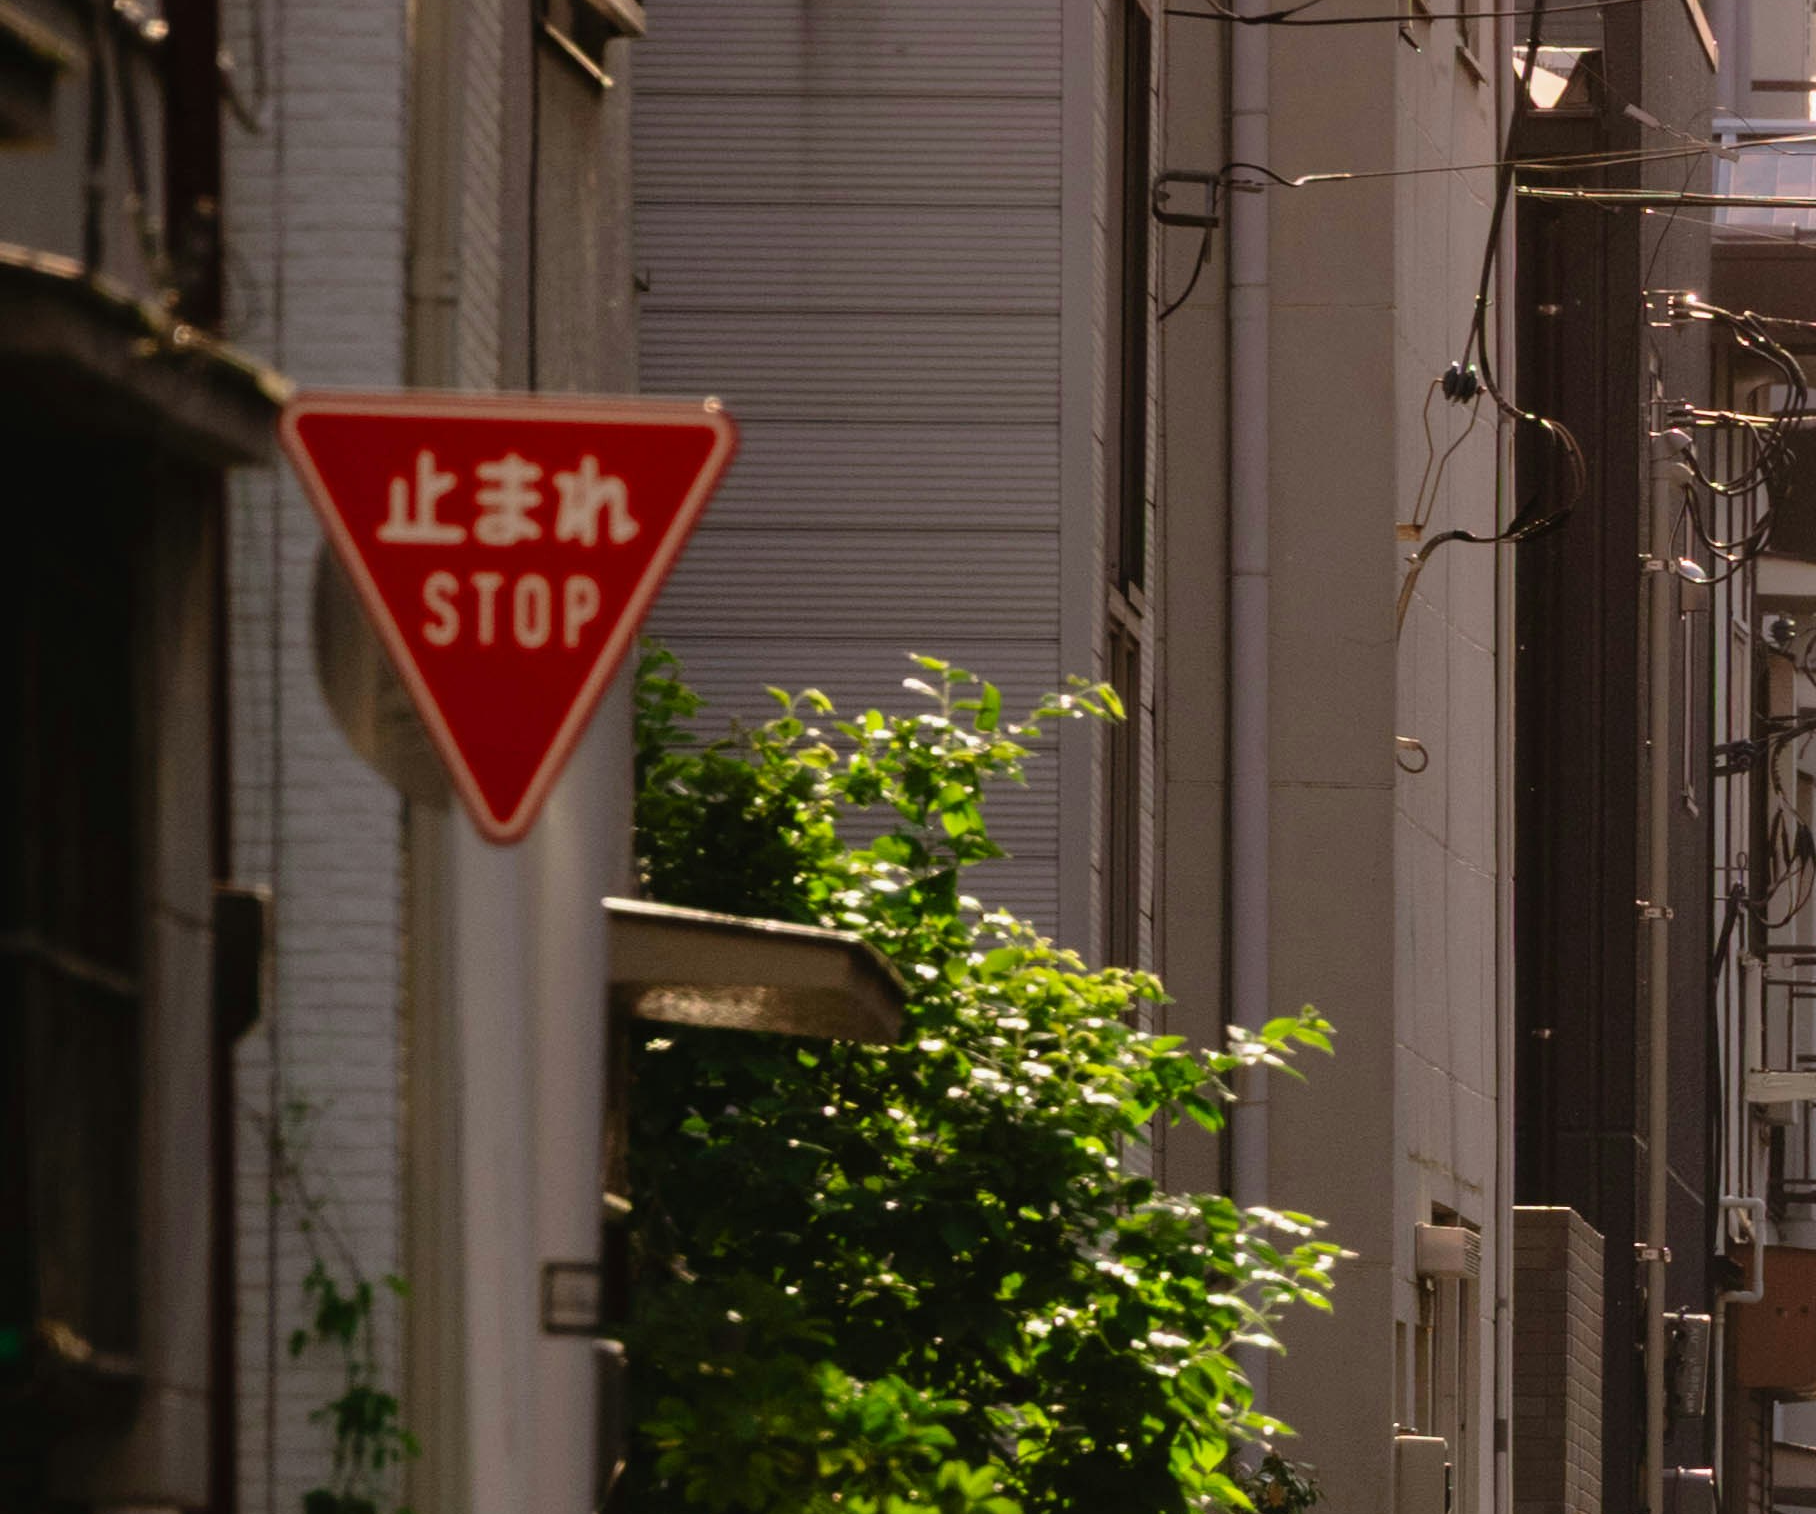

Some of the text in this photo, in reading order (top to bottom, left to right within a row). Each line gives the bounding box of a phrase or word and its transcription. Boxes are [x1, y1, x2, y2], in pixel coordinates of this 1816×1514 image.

[376, 448, 641, 547] 止まれ
[422, 570, 602, 649] STOP
